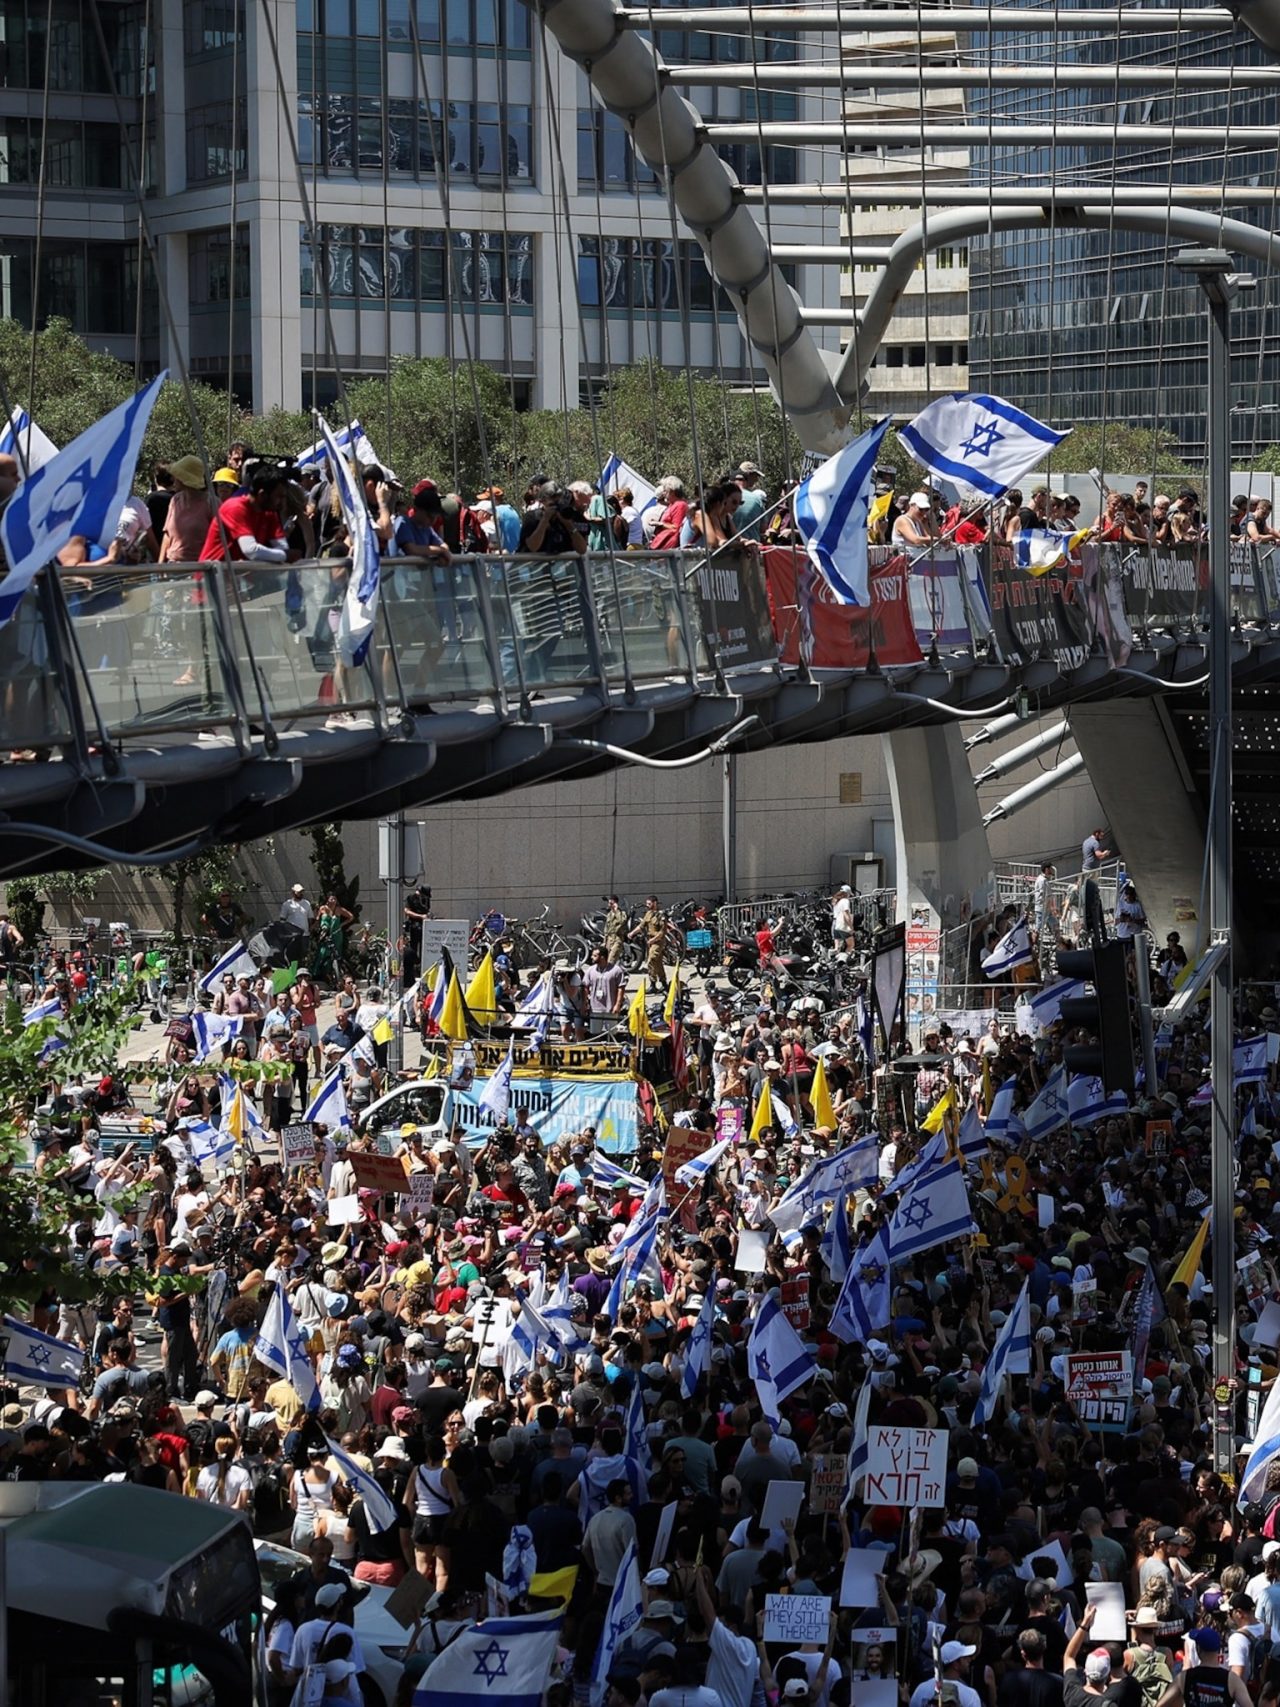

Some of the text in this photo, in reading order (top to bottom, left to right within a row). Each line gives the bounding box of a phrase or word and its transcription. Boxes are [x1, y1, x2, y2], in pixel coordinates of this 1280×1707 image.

[1080, 1400, 1126, 1422] היום!
[877, 1428, 937, 1448] זה לא
[890, 1446, 931, 1473] בוץ
[867, 1472, 941, 1502] זה חרא
[771, 1595, 823, 1612] WHY ARE
[766, 1609, 829, 1626] THEY STILL
[779, 1624, 822, 1640] THERE?
